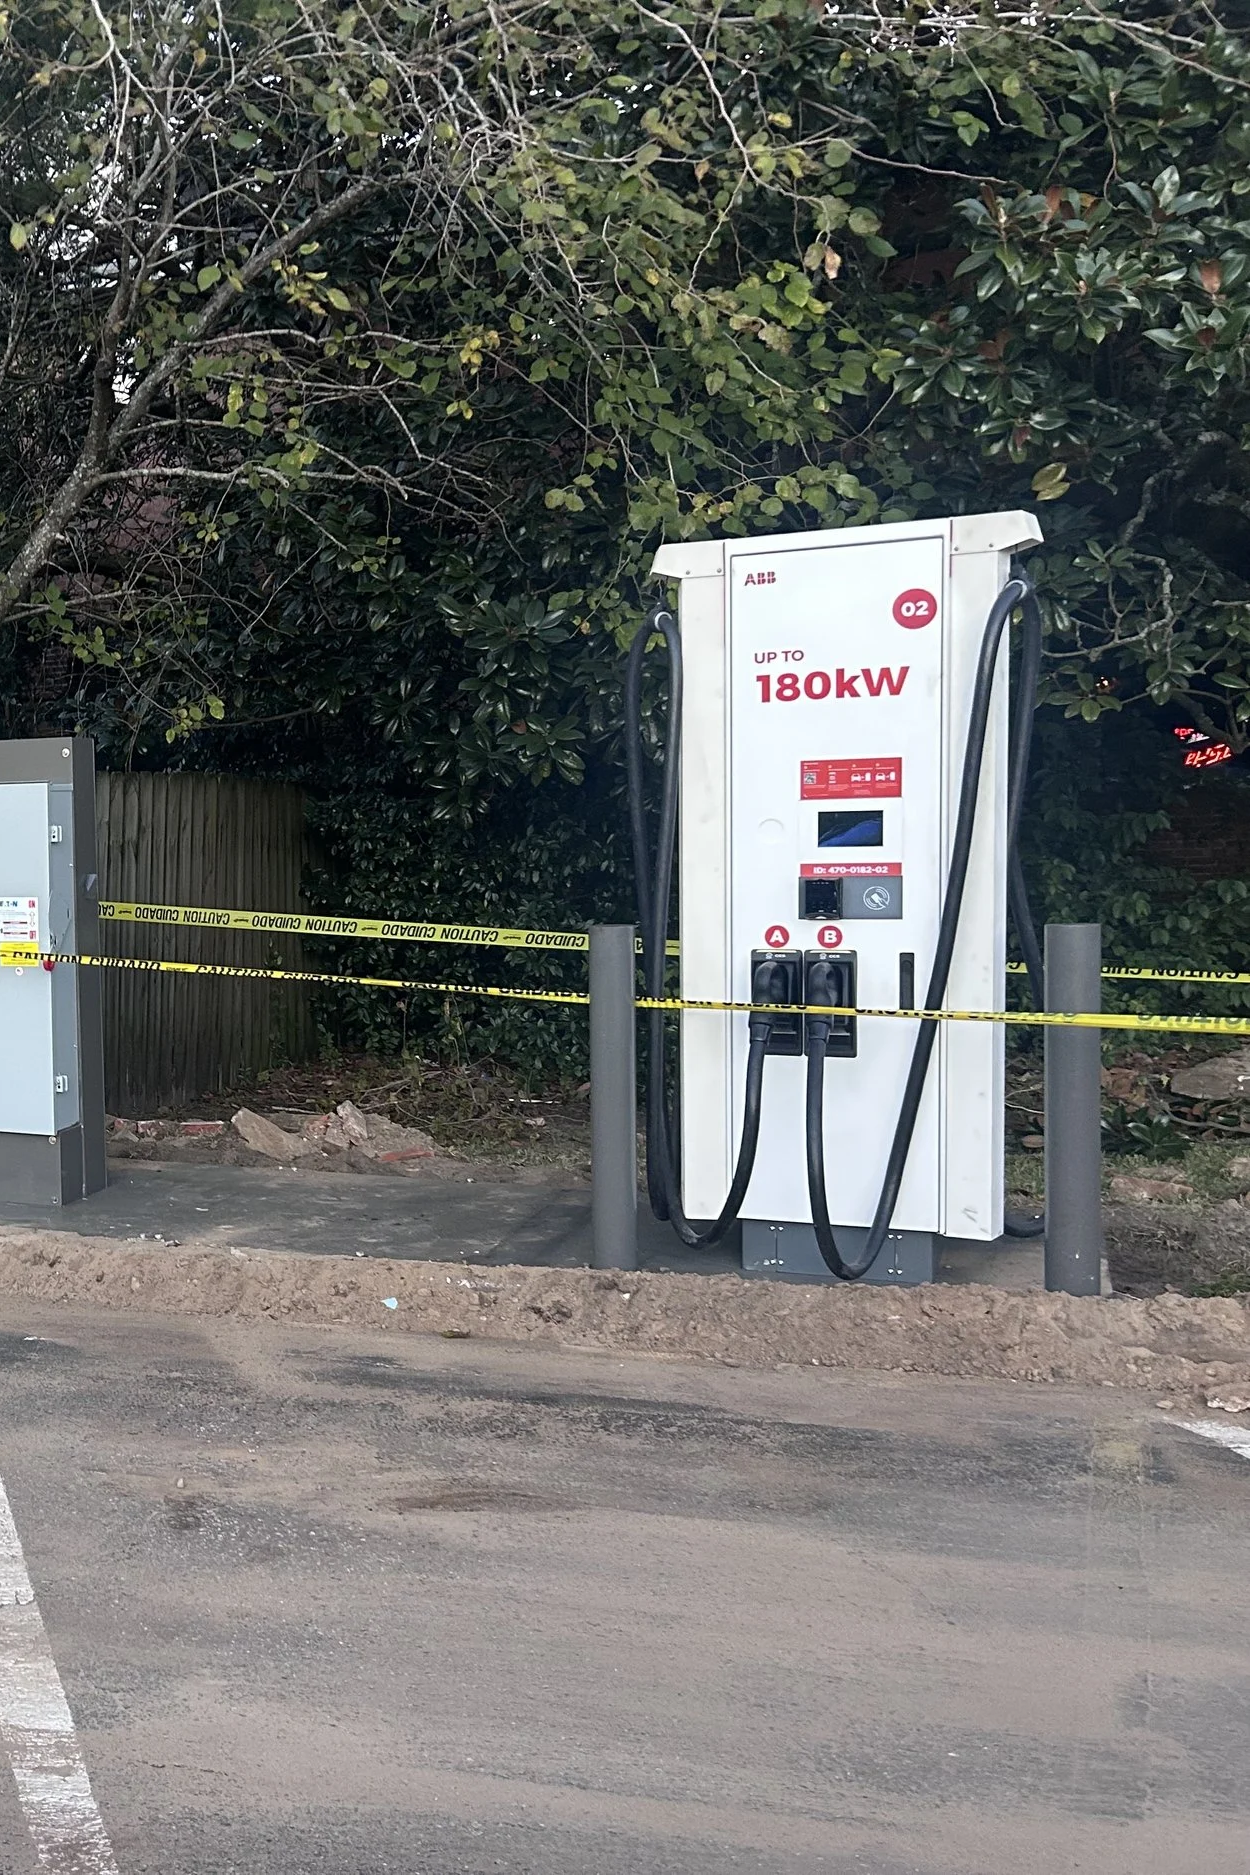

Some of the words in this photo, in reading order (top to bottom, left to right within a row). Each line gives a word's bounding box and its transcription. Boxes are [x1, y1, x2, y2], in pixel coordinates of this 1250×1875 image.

[744, 571, 776, 586] ABB
[901, 600, 929, 617] 02
[754, 652, 777, 664] UP
[781, 650, 804, 662] TO
[756, 666, 910, 703] 180kW
[135, 907, 179, 921] CUIDADO
[183, 910, 230, 925] CAUTION
[252, 915, 300, 930] CUIDADO
[305, 918, 357, 934] CAUTION
[381, 923, 436, 938] CUIDADO
[440, 928, 498, 942] CAUTION
[769, 929, 785, 943] A
[823, 929, 838, 943] B
[525, 933, 586, 947] CUIDADO
